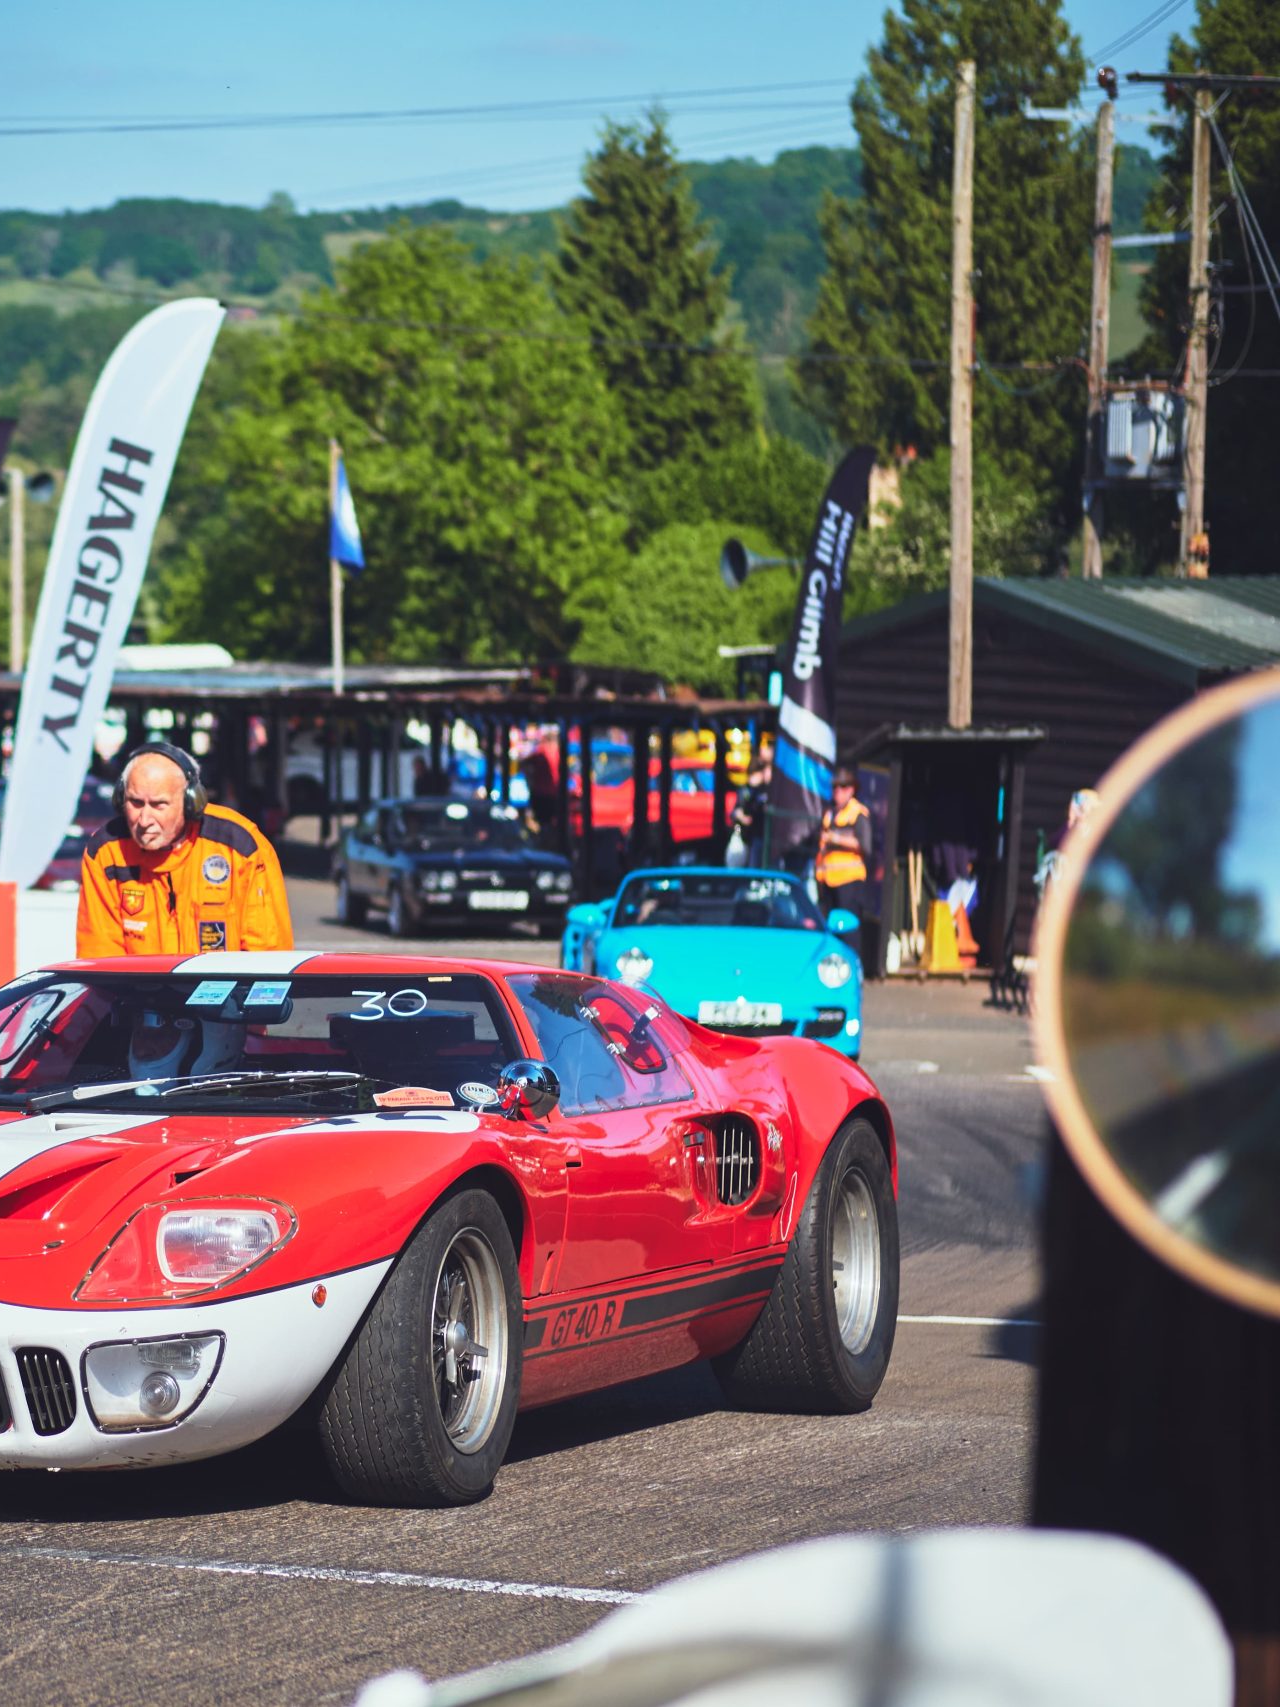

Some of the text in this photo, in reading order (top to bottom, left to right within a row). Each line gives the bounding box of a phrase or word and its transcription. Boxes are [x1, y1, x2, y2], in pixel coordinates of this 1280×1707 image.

[42, 437, 155, 754] HAGERTY
[793, 499, 842, 680] Hill Climb
[350, 988, 428, 1021] 30
[600, 1300, 616, 1337] R
